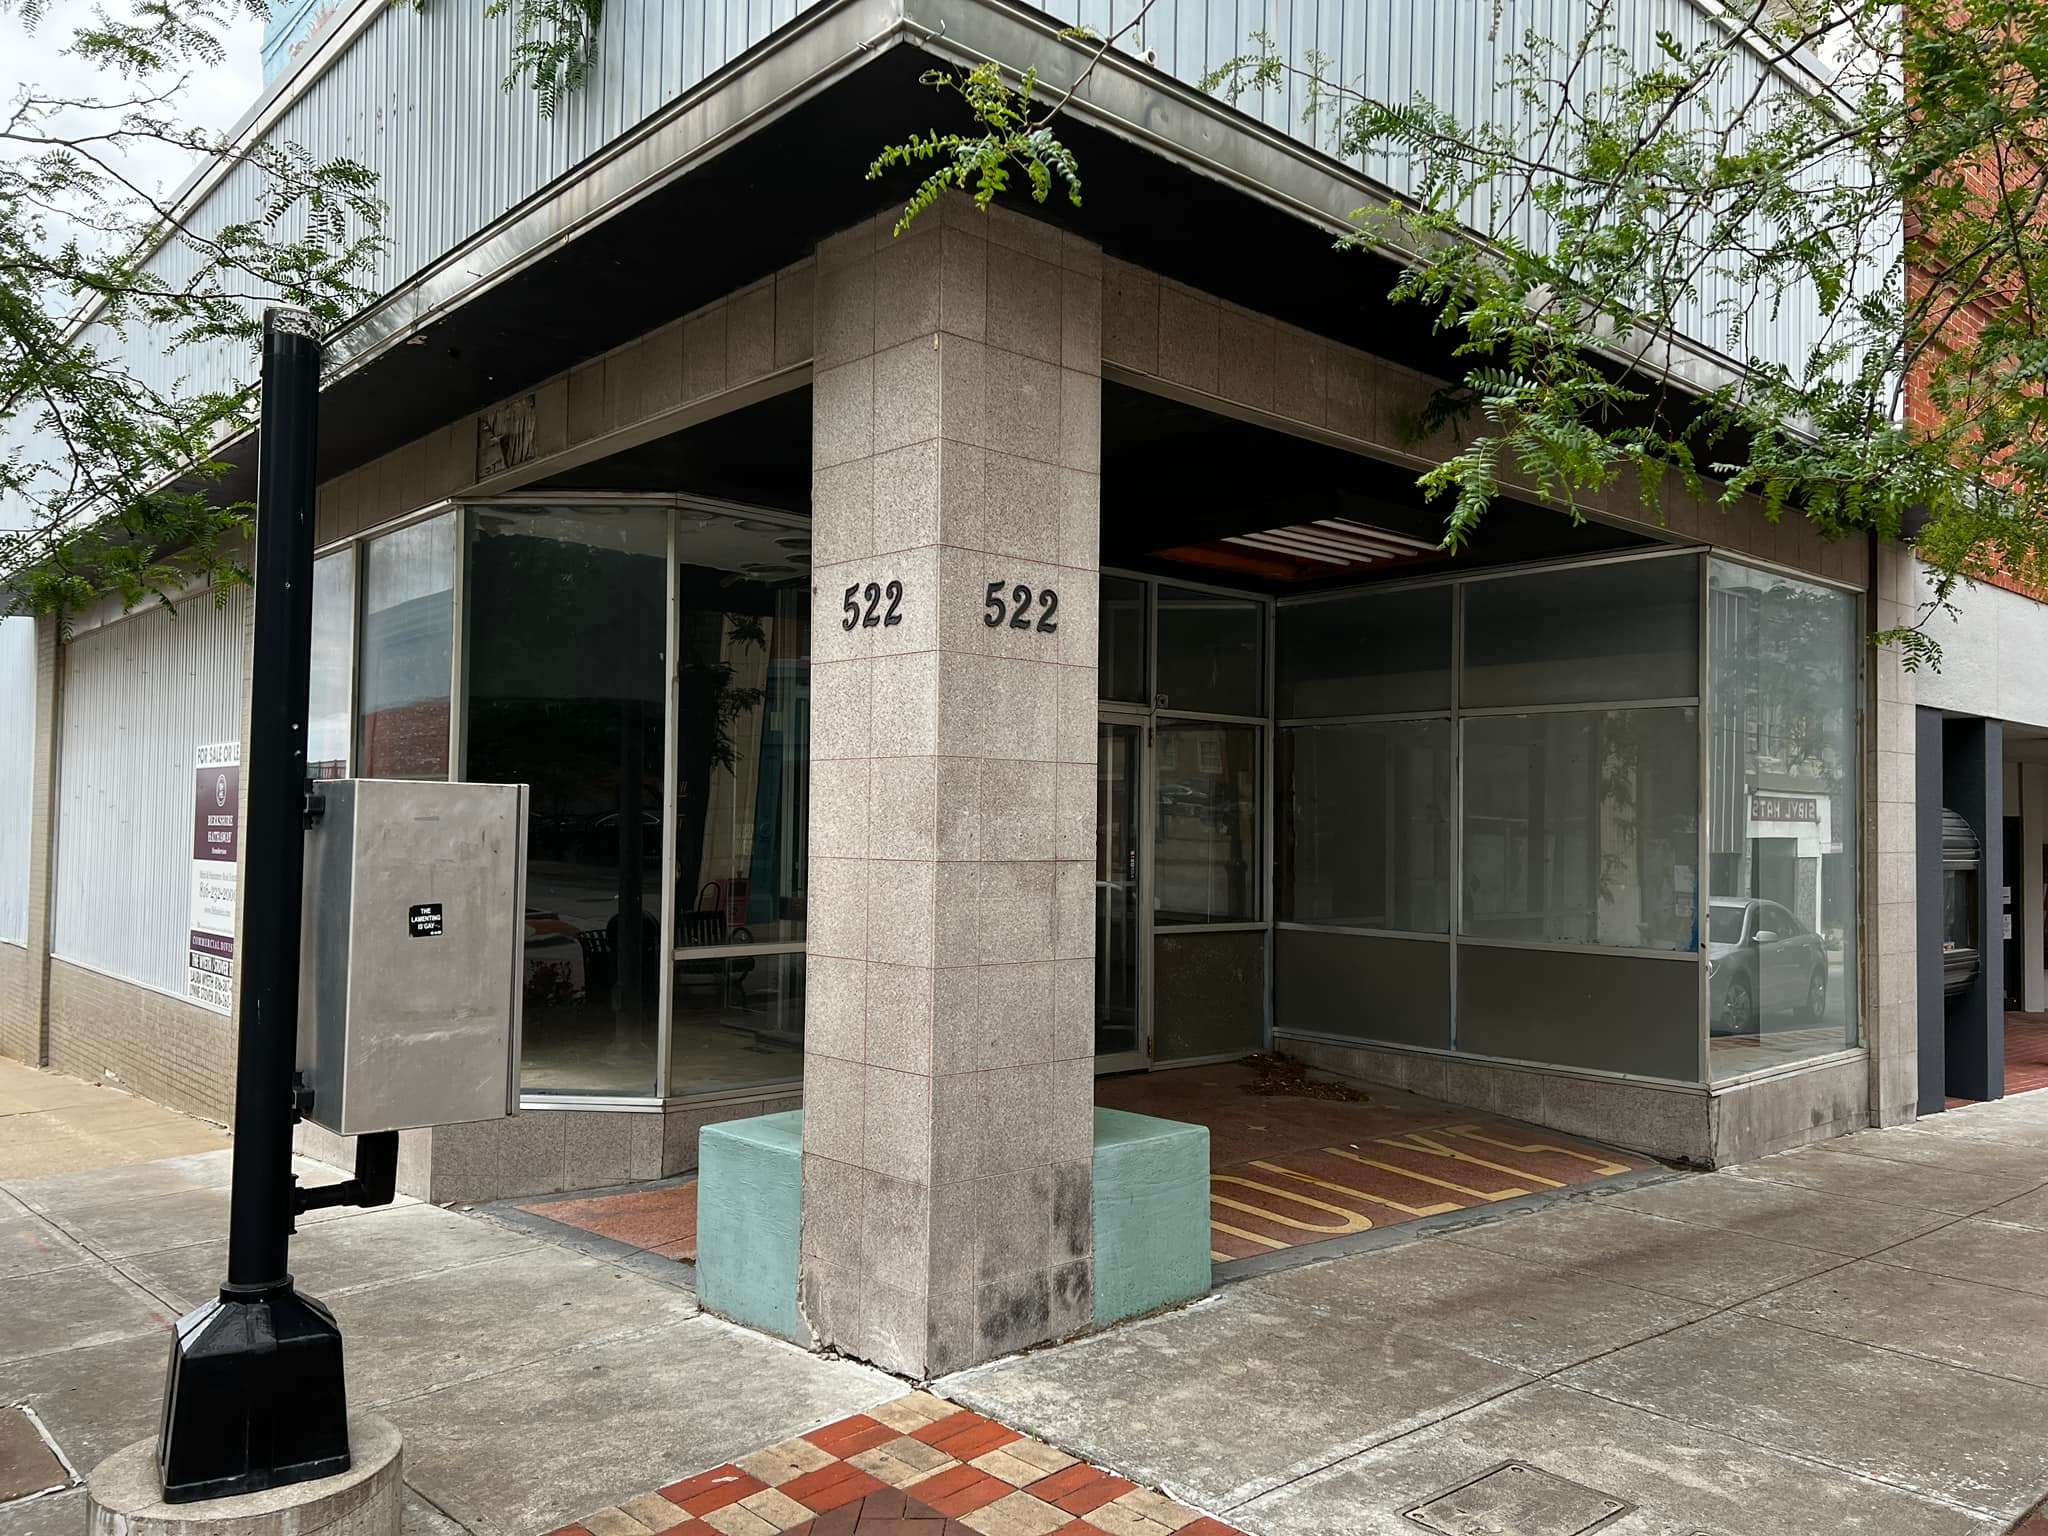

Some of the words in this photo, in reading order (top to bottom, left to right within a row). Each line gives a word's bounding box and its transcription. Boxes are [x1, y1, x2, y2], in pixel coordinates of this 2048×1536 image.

[842, 580, 904, 632] 522
[983, 580, 1059, 634] 522
[198, 747, 208, 764] FOR
[209, 745, 222, 763] SALE
[223, 744, 232, 762] OR
[411, 915, 440, 923] LAMENTING
[192, 935, 220, 951] COMMERCIAL
